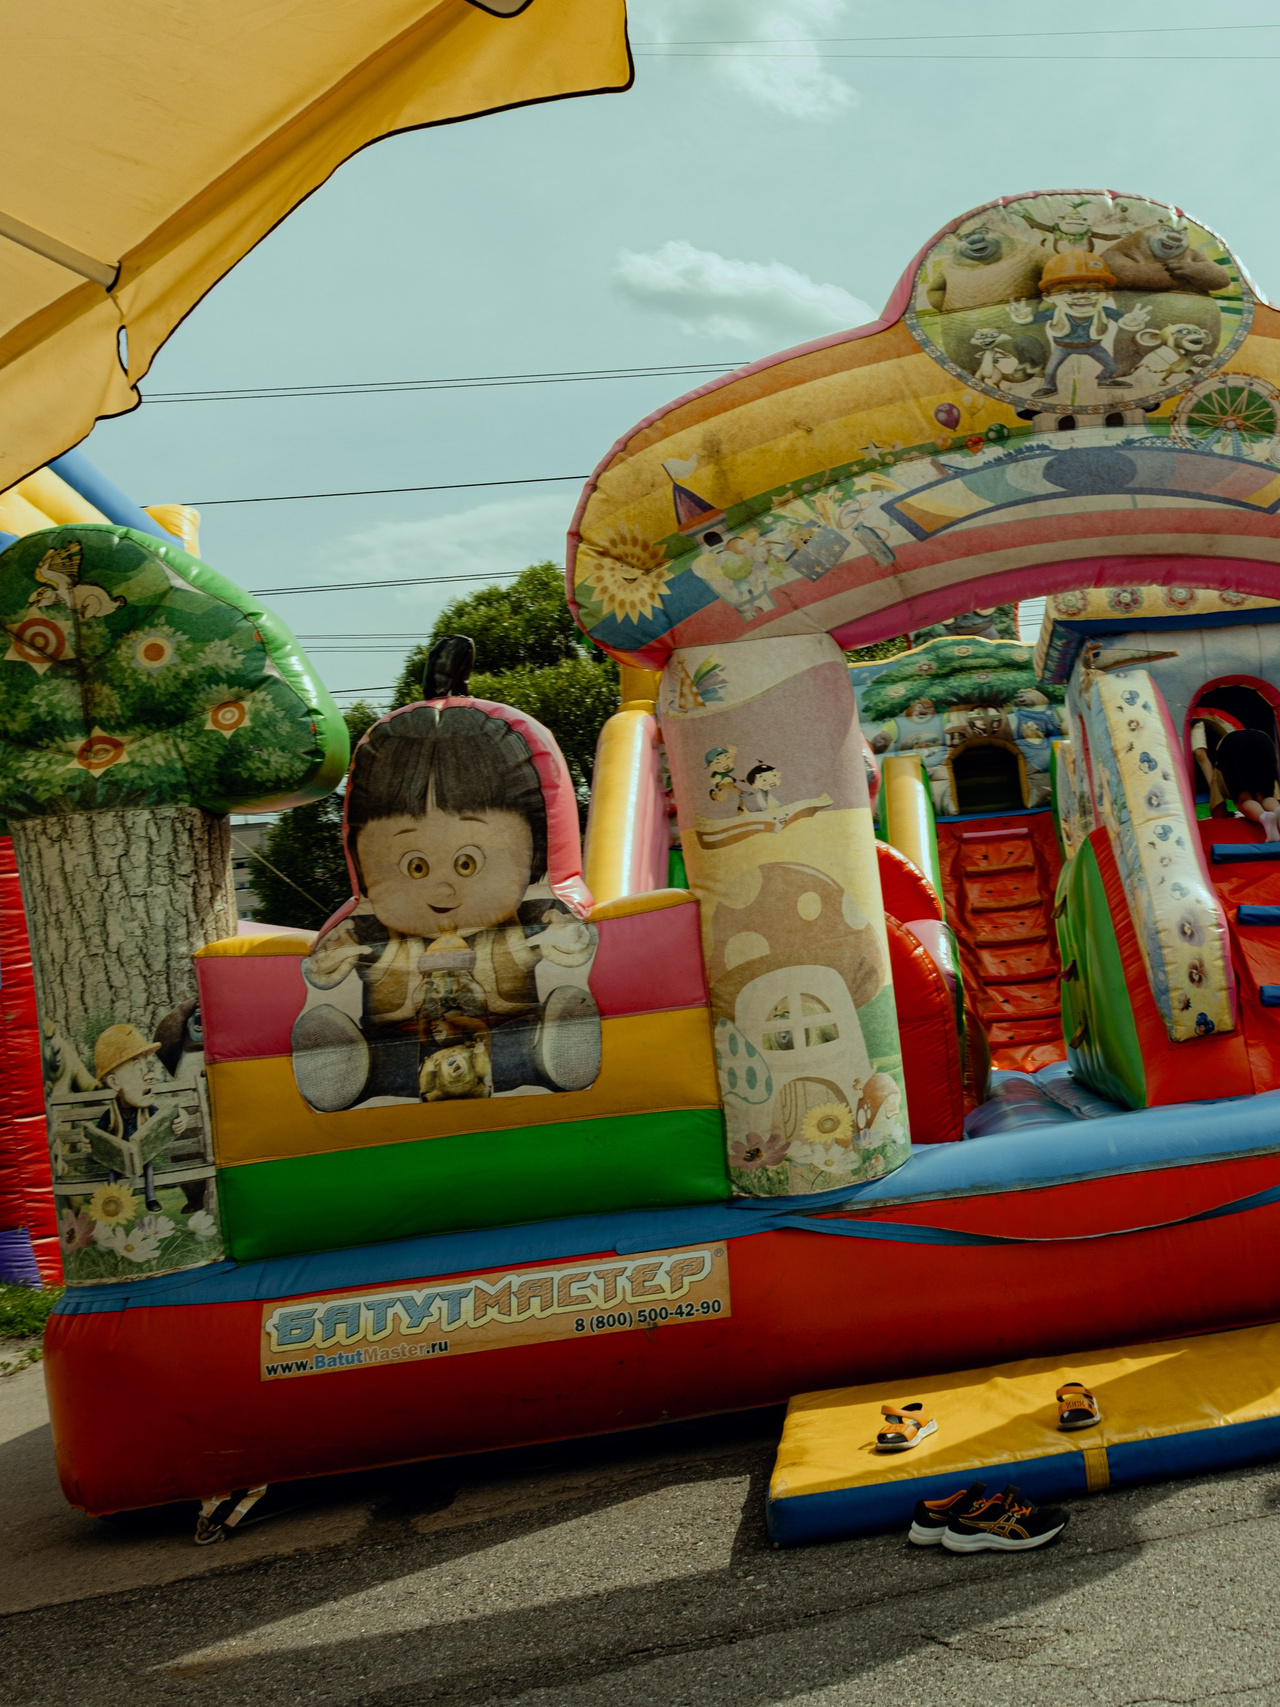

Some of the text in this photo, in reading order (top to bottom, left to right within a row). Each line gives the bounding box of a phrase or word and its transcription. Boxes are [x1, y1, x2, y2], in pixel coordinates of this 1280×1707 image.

[270, 1254, 707, 1347] БАТУТМАСТЕР
[575, 1299, 722, 1333] 8 (800) 500-42-90
[265, 1339, 449, 1376] www.BatutMaster.ru
